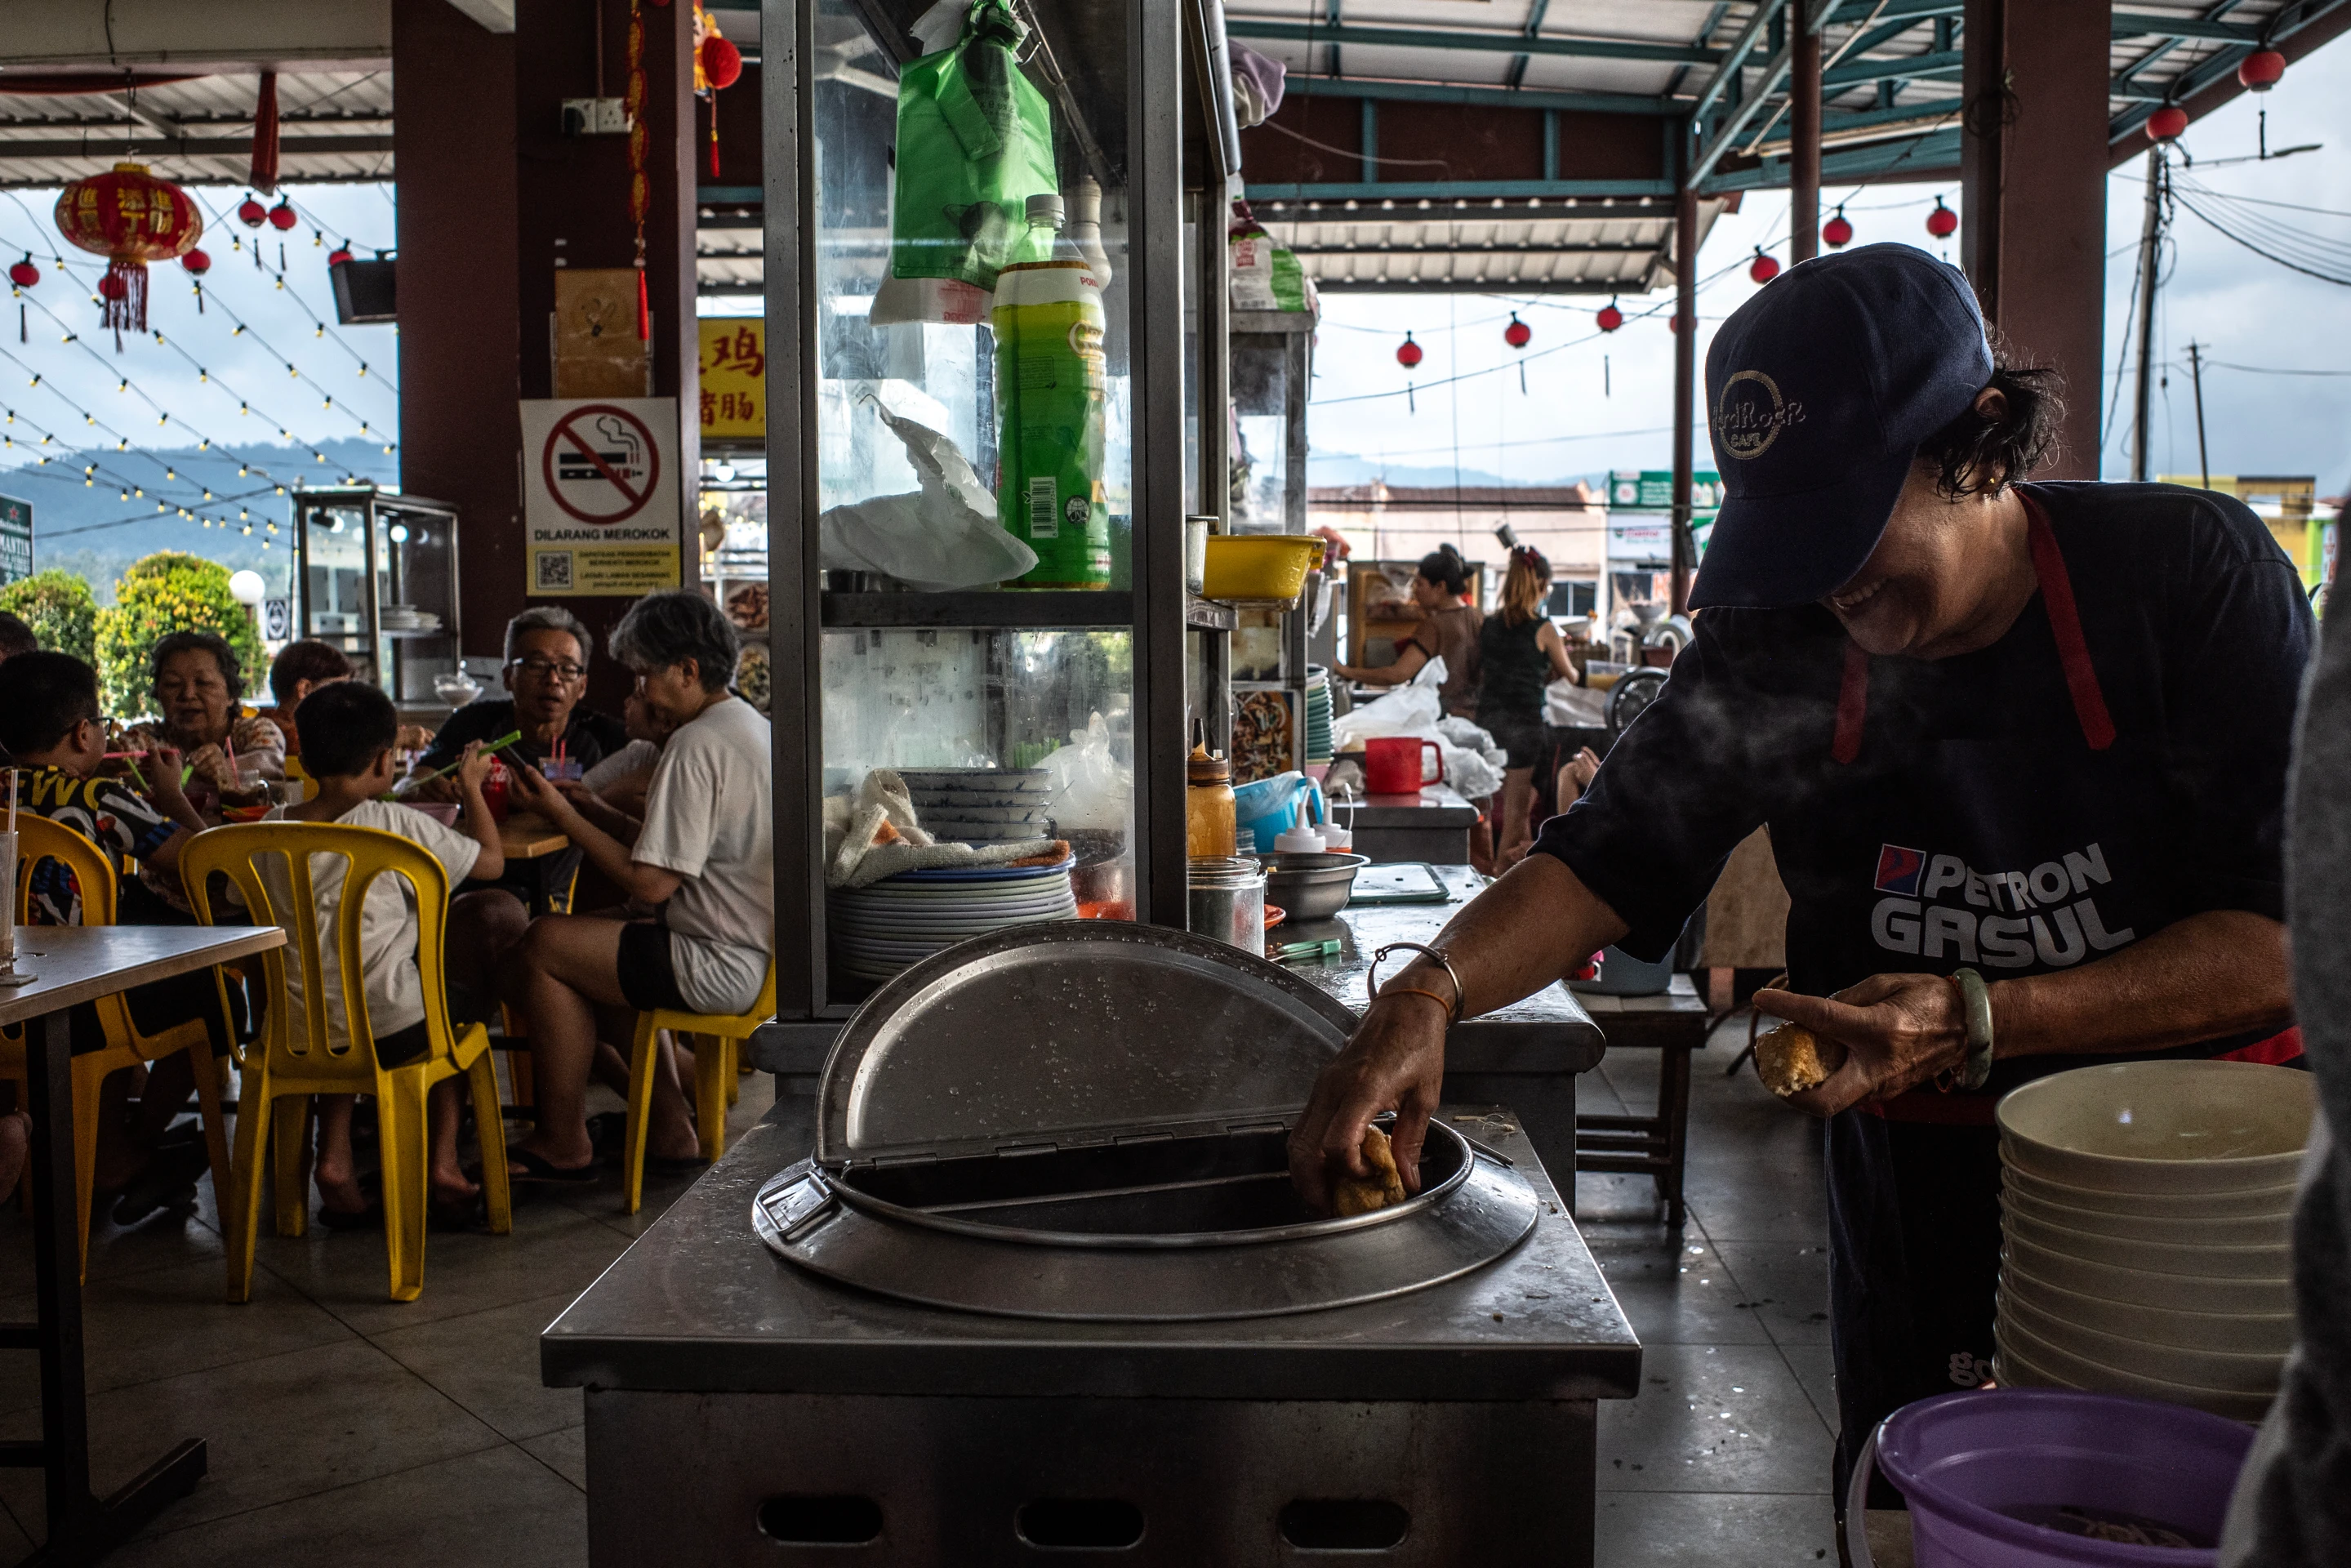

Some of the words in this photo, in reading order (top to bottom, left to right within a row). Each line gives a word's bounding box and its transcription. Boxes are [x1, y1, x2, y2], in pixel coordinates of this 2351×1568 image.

[535, 528, 600, 541] DILARANG
[603, 528, 670, 541] MEROKOK
[1923, 842, 2113, 911] PETRON
[1871, 897, 2135, 969] GASUL
